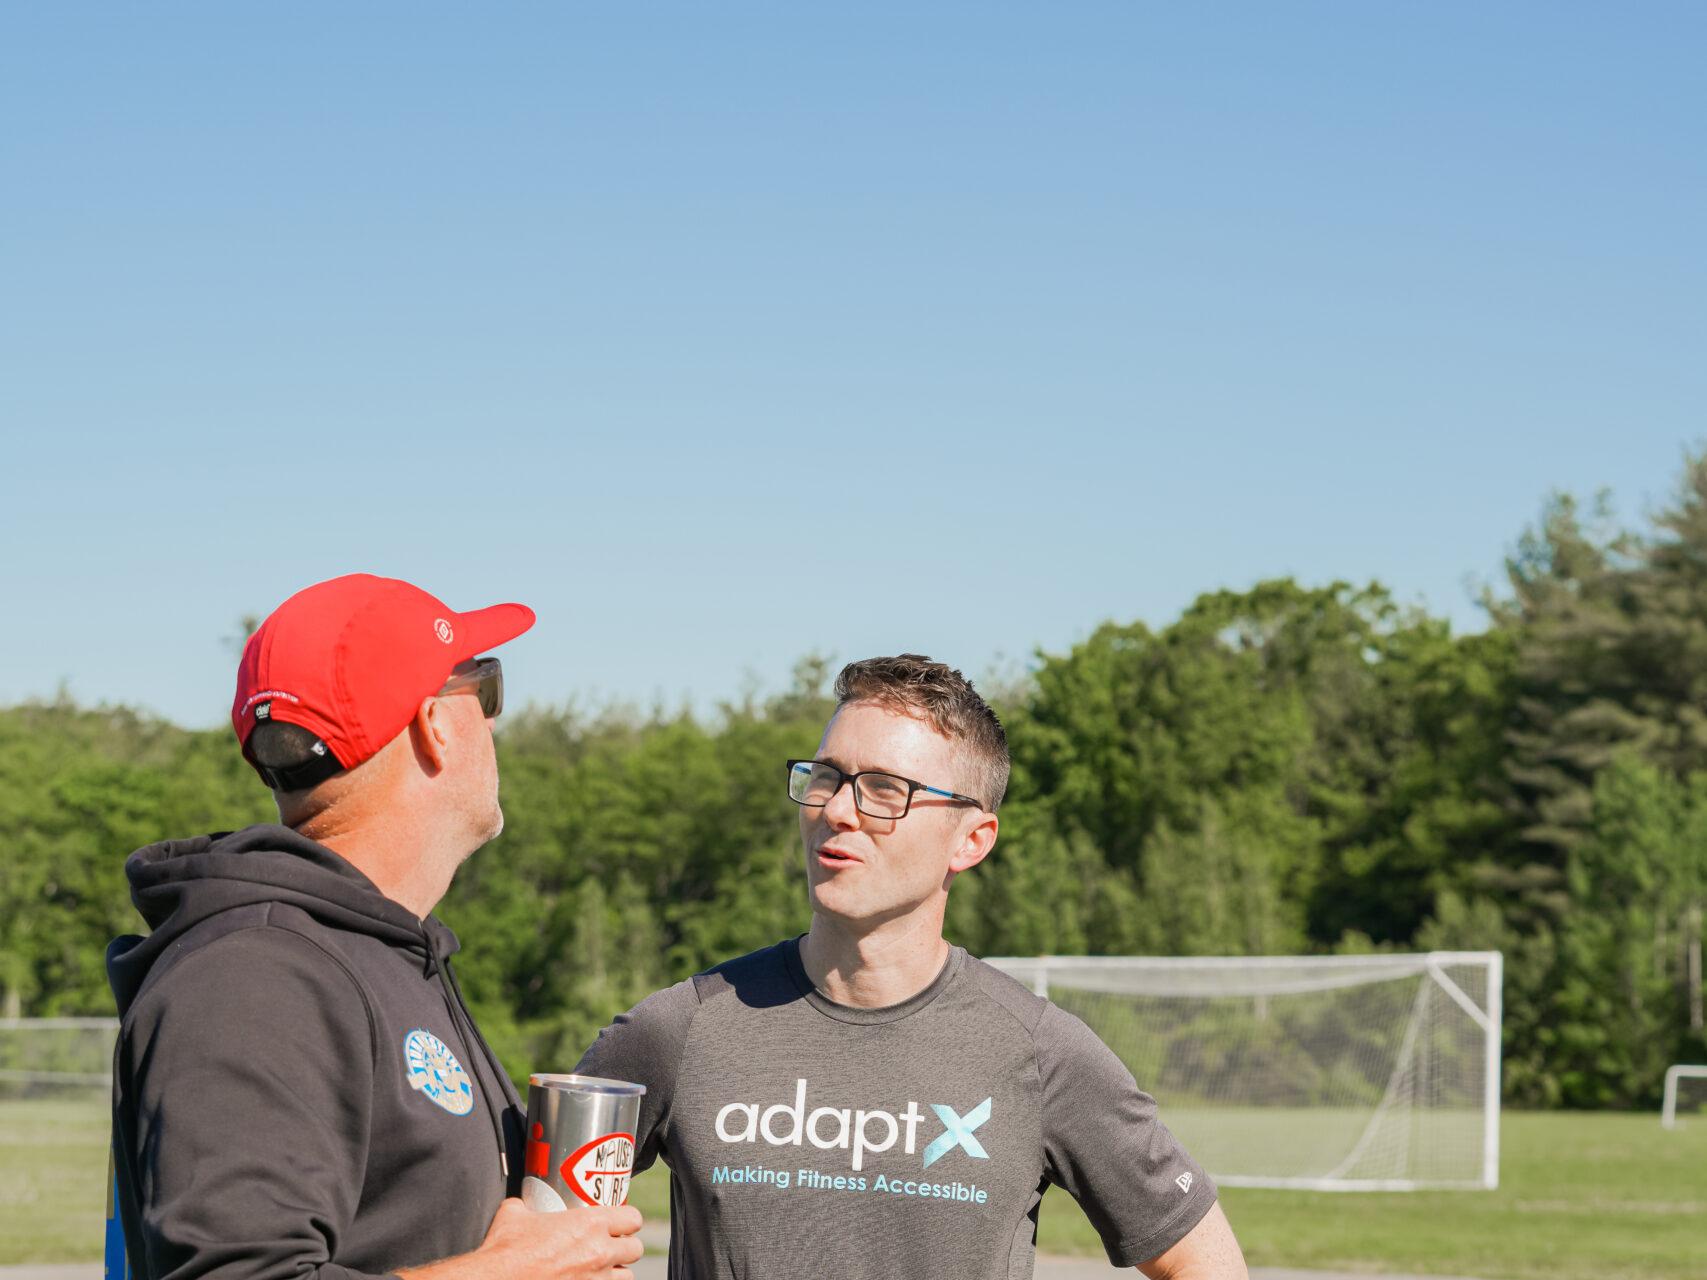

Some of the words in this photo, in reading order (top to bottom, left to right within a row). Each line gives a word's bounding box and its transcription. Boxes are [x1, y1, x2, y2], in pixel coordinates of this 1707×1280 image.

[593, 1177, 624, 1206] SURF
[712, 1165, 790, 1188] Making
[797, 1169, 866, 1191] Fitness
[873, 1174, 988, 1204] Accessible
